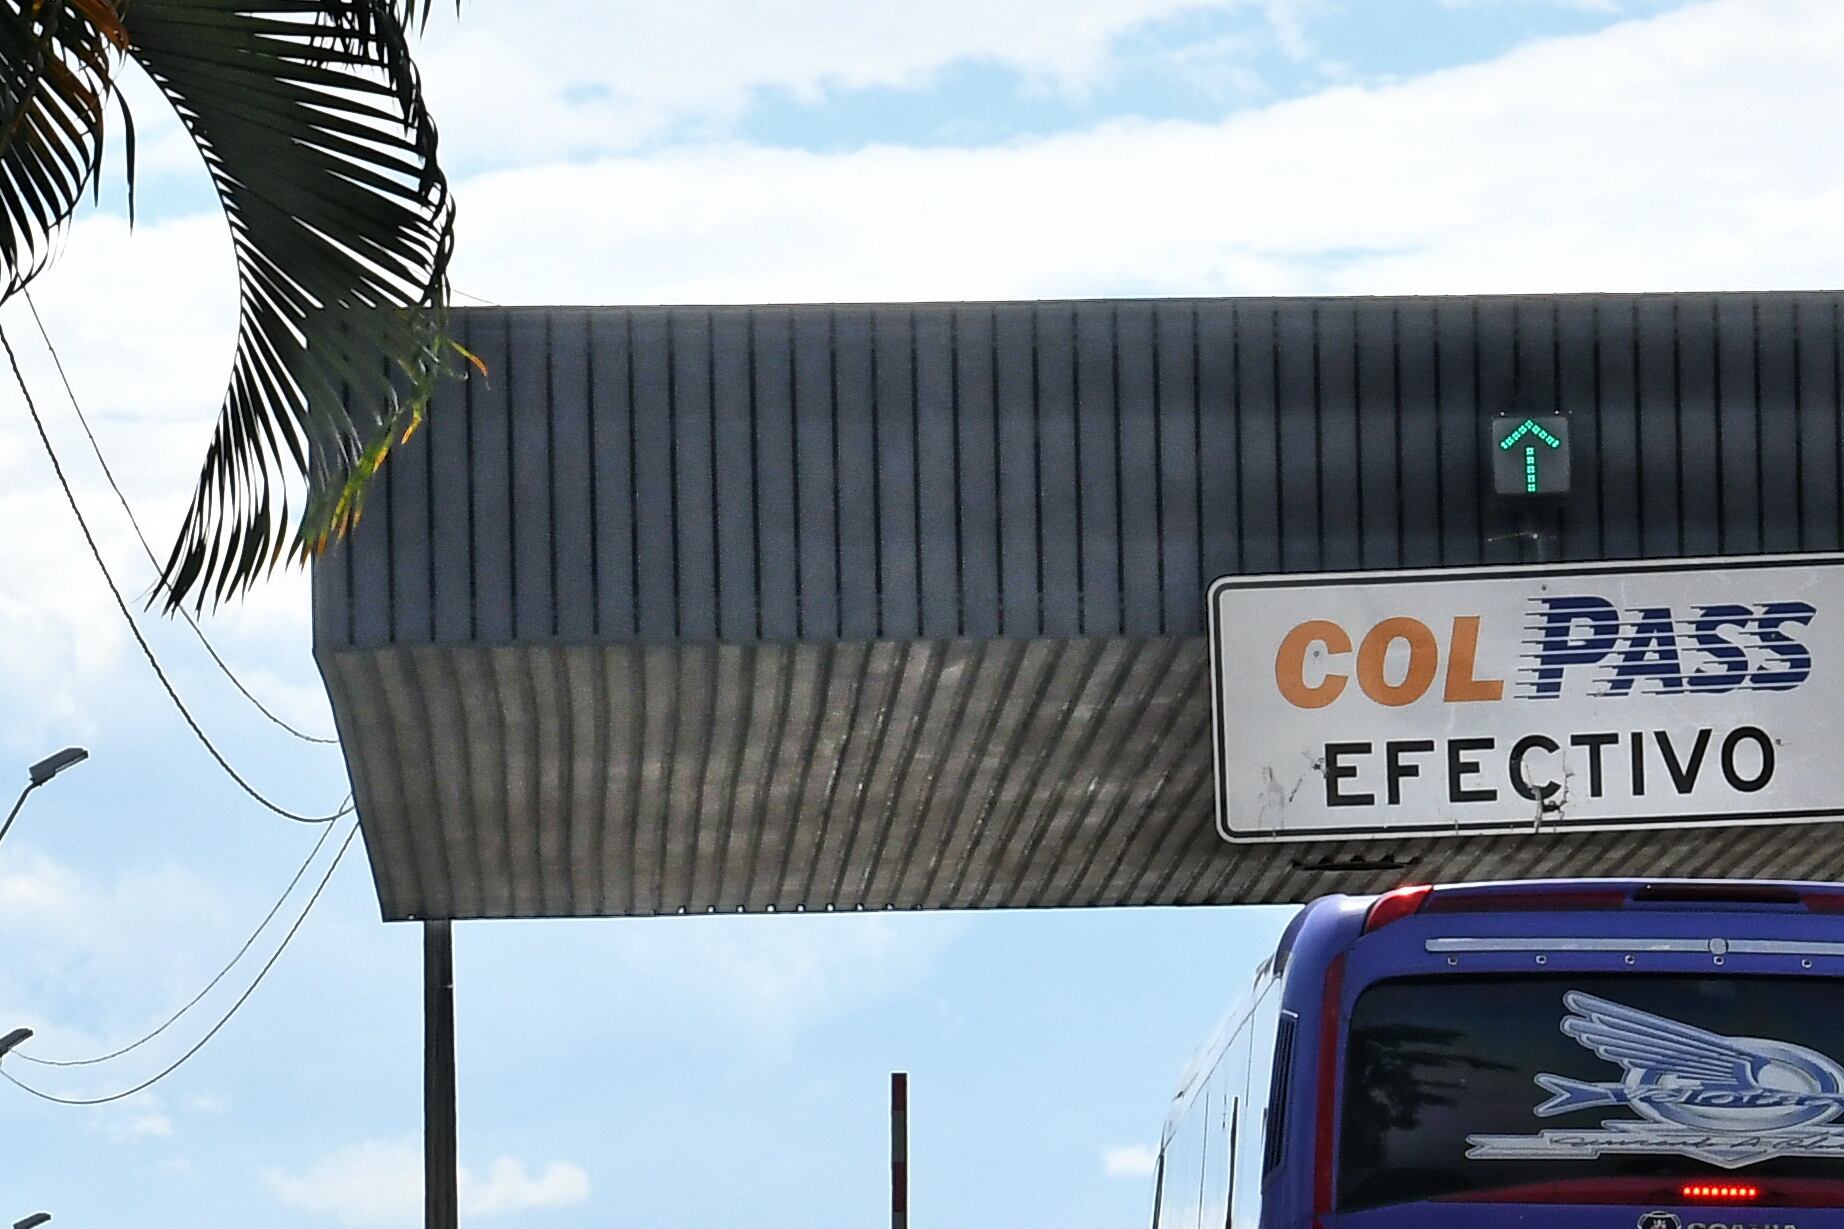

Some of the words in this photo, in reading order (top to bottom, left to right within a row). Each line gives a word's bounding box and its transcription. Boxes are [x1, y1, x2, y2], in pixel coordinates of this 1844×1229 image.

[1274, 615, 1504, 709] COL
[1514, 595, 1818, 700] PASS
[1324, 726, 1776, 807] EFECTIVO
